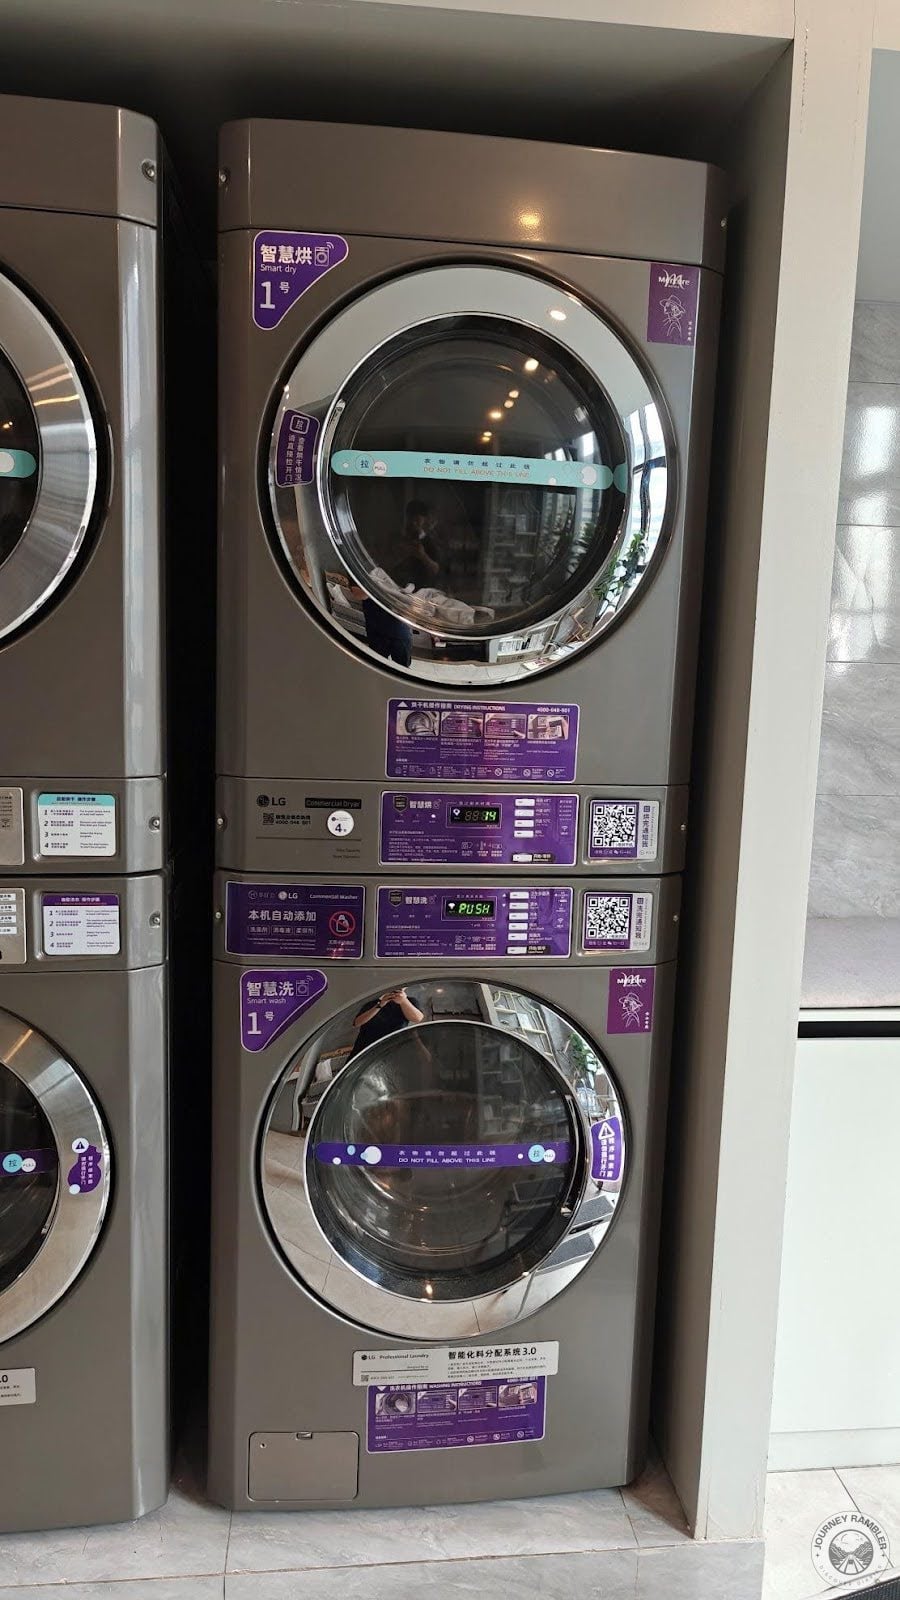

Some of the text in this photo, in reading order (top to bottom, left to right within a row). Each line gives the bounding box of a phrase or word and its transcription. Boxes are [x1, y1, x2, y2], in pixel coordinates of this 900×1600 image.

[260, 244, 312, 265] 智慧烘
[260, 264, 297, 275] Smart dry
[260, 281, 290, 309] 1 号
[271, 797, 286, 806] LG
[306, 799, 361, 808] Commercial Dryer
[409, 800, 432, 809] 智慧烘
[288, 892, 298, 900] LG
[405, 896, 428, 905] 智慧洗
[458, 902, 490, 914] PUSH
[248, 909, 317, 922] 本机自动添加
[246, 981, 295, 997] 智慧洗
[247, 1011, 275, 1035] 1 号
